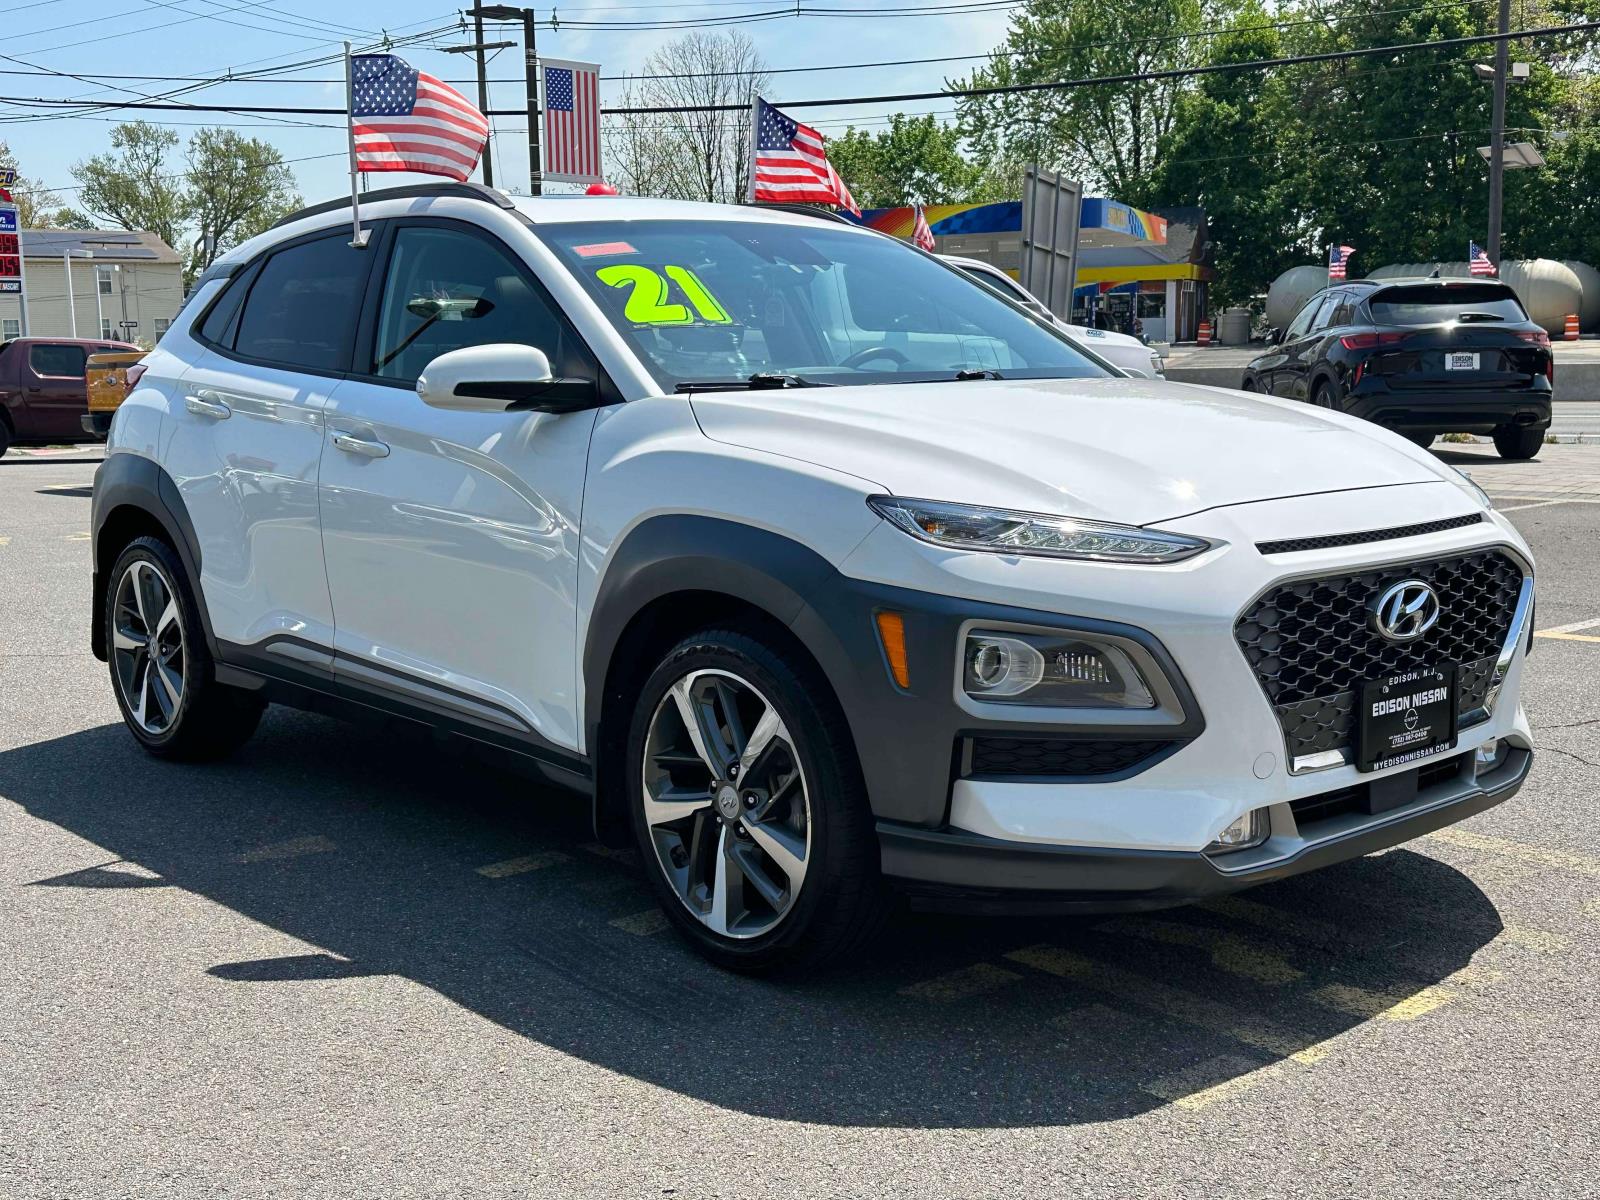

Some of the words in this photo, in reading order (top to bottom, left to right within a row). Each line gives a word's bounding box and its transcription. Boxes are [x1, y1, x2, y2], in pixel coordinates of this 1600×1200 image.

[596, 264, 733, 324] 21
[1389, 672, 1420, 685] EDISON,
[1423, 668, 1438, 677] N.J.
[1372, 695, 1410, 717] EDISON
[1412, 687, 1447, 708] NISSAN
[1373, 743, 1450, 771] MYEDISONNISSAN.COM
